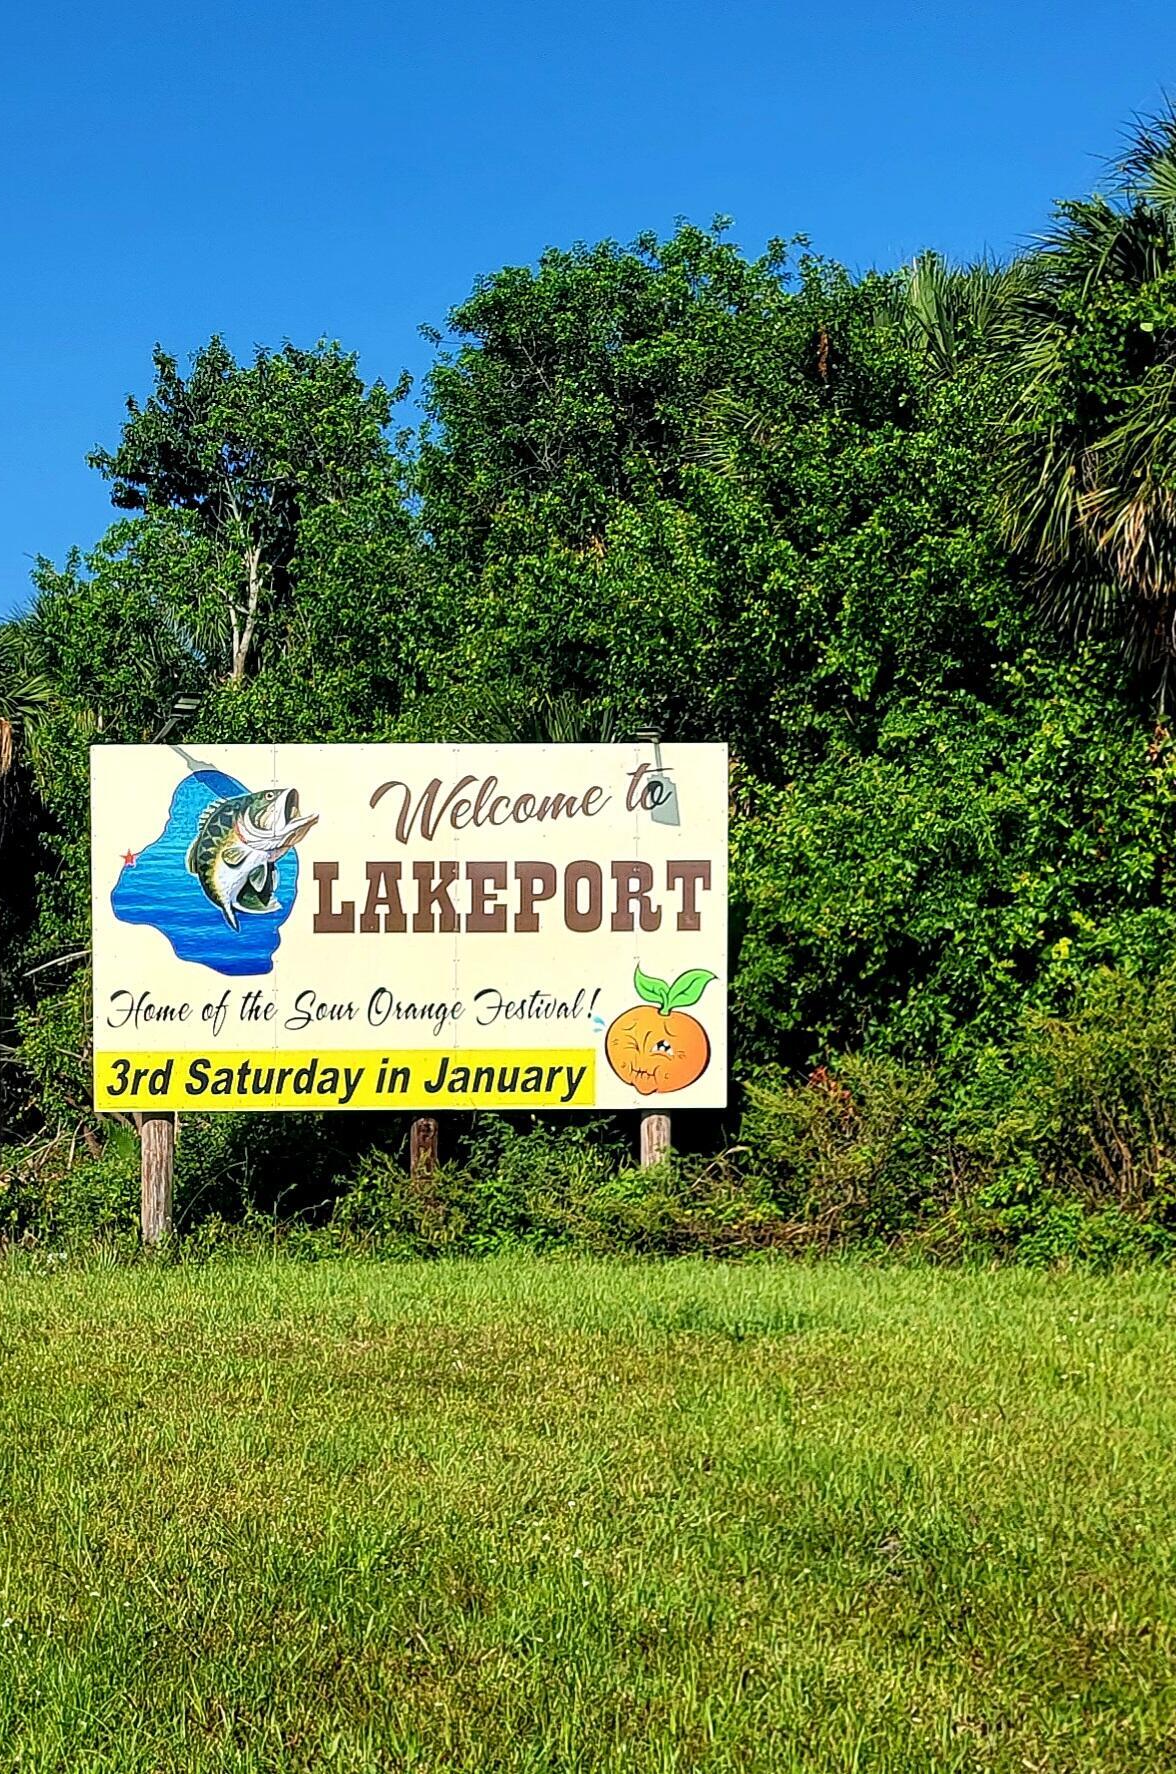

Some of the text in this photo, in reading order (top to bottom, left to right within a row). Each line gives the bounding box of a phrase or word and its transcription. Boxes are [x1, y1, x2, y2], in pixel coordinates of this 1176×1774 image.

[369, 763, 674, 844] Welcome to
[313, 860, 712, 933] LAKEPORT
[106, 987, 601, 1035] Home of the Sour Orange Festival!
[106, 1057, 587, 1104] 3rd Saturday in January
